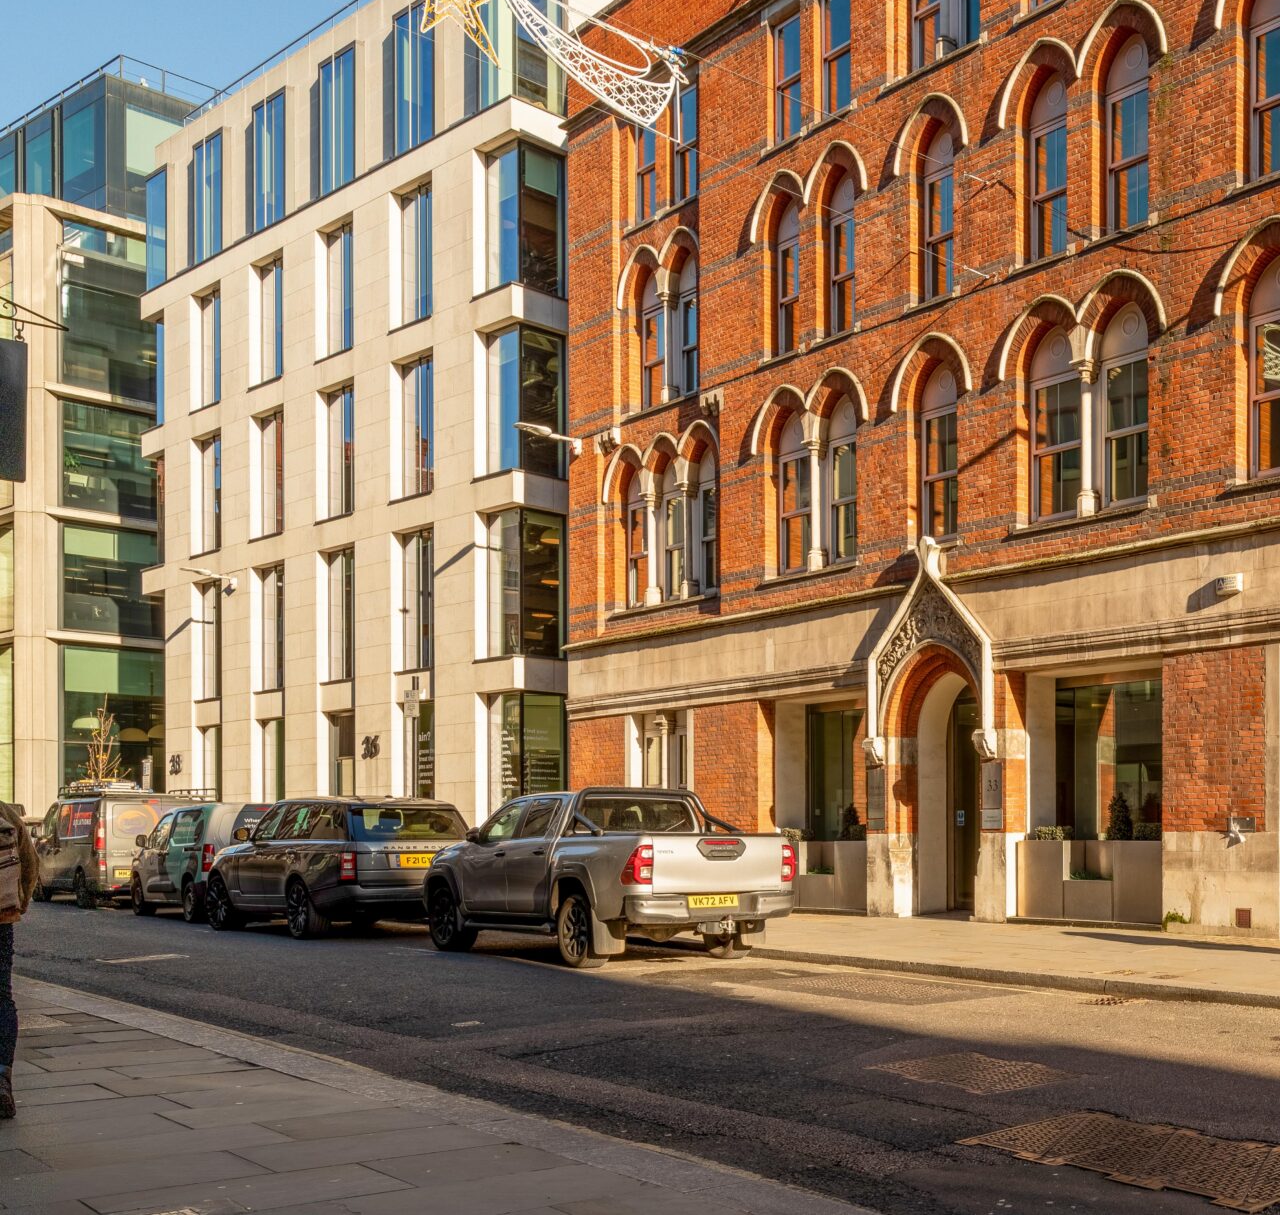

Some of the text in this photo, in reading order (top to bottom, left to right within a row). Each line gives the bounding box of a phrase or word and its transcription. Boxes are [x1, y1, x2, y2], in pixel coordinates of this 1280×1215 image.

[418, 731, 431, 742] ain?
[361, 735, 381, 760] 36
[169, 754, 182, 776] 38
[987, 779, 998, 792] 33
[406, 856, 420, 865] F21
[692, 896, 735, 906] VK72 AFV
